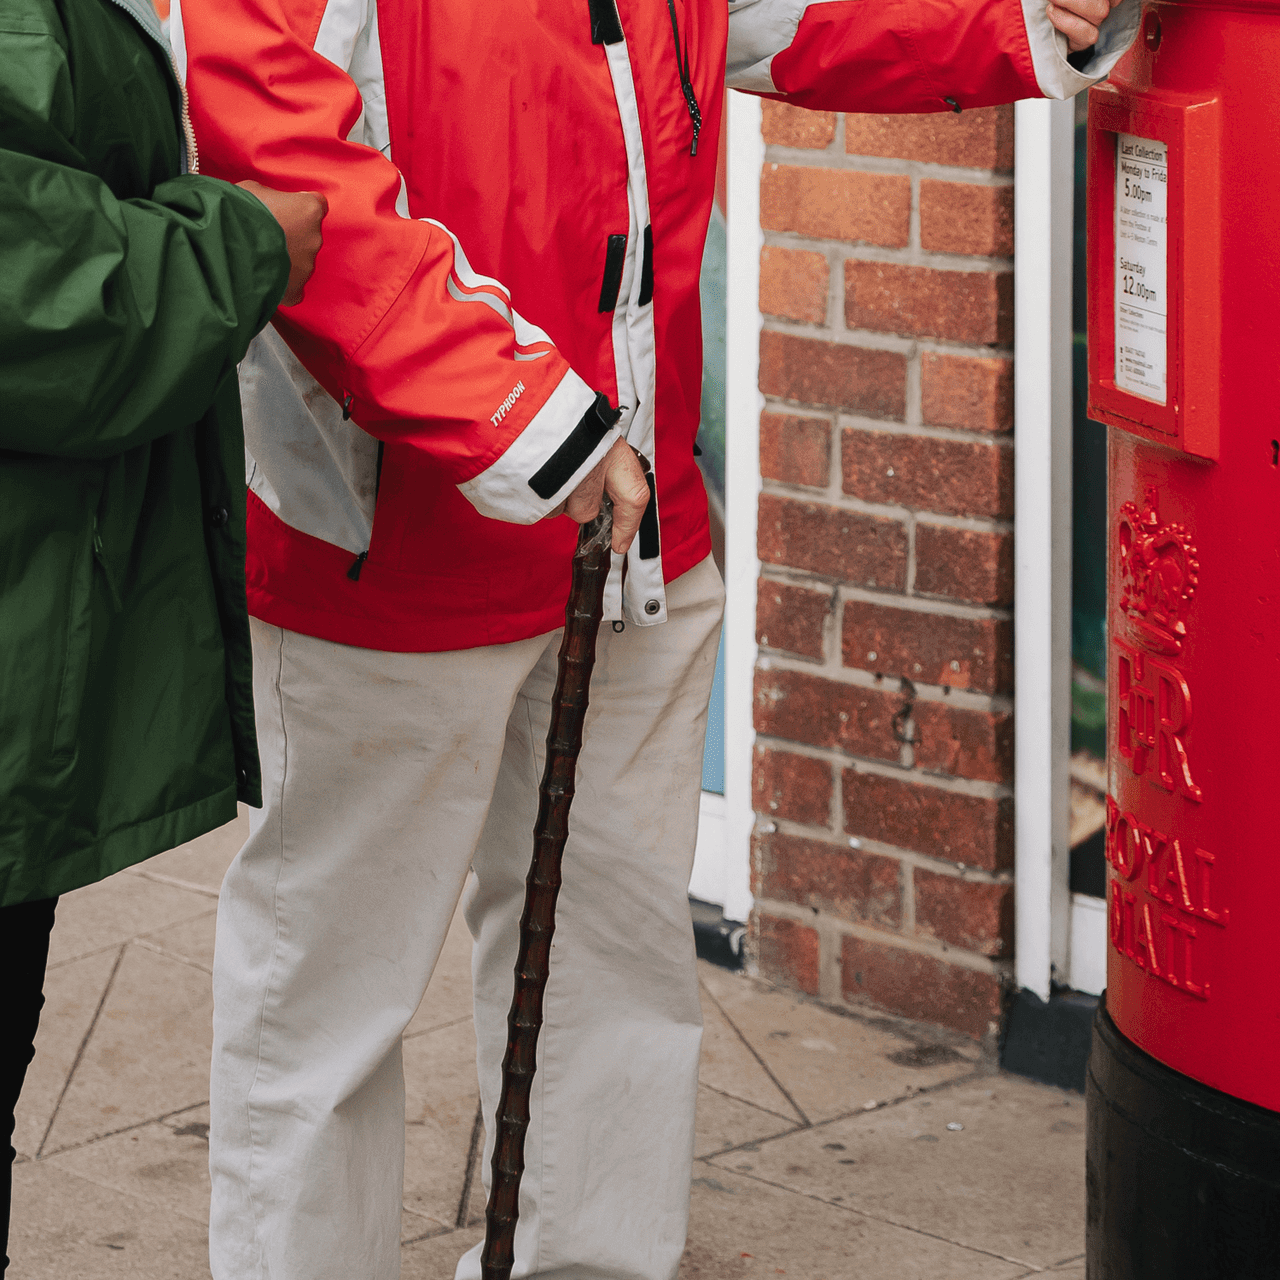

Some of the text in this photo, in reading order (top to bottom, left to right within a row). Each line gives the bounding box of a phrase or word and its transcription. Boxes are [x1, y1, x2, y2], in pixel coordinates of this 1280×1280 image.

[1121, 142, 1163, 162] Last Collection
[1121, 161, 1143, 179] Monday
[1144, 168, 1150, 179] to
[1125, 178, 1152, 204] 5.00pm
[1120, 257, 1146, 277] Saturday
[1123, 274, 1157, 302] 12.00pm
[490, 379, 526, 427] TYPHOON
